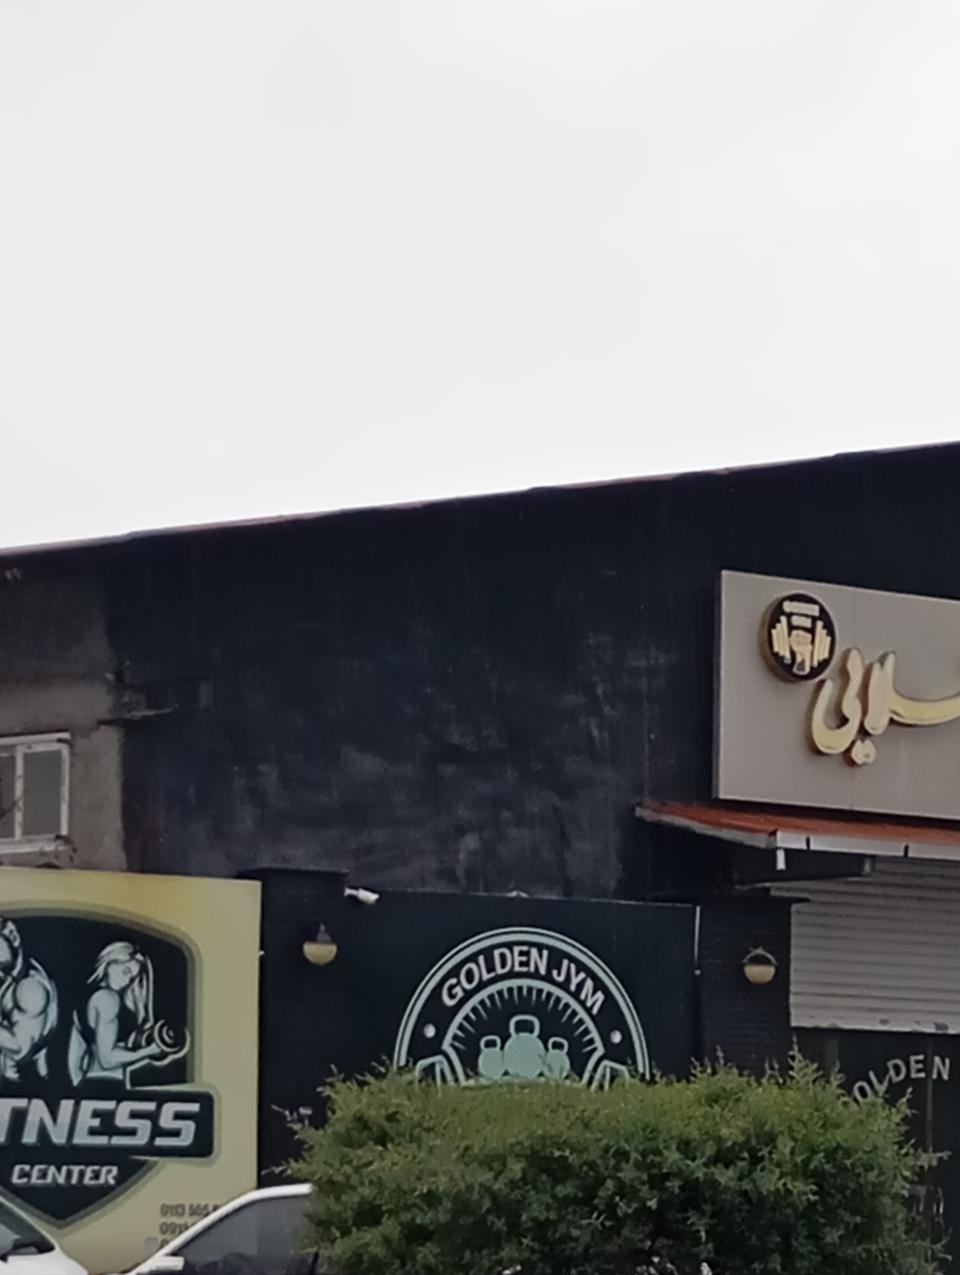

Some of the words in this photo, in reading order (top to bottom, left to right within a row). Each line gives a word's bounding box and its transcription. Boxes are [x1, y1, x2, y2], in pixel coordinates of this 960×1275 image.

[441, 945, 549, 1007] GOLDEN
[552, 958, 606, 1016] JYM
[852, 1054, 951, 1103] OLDEN
[11, 1163, 119, 1185] CENTER
